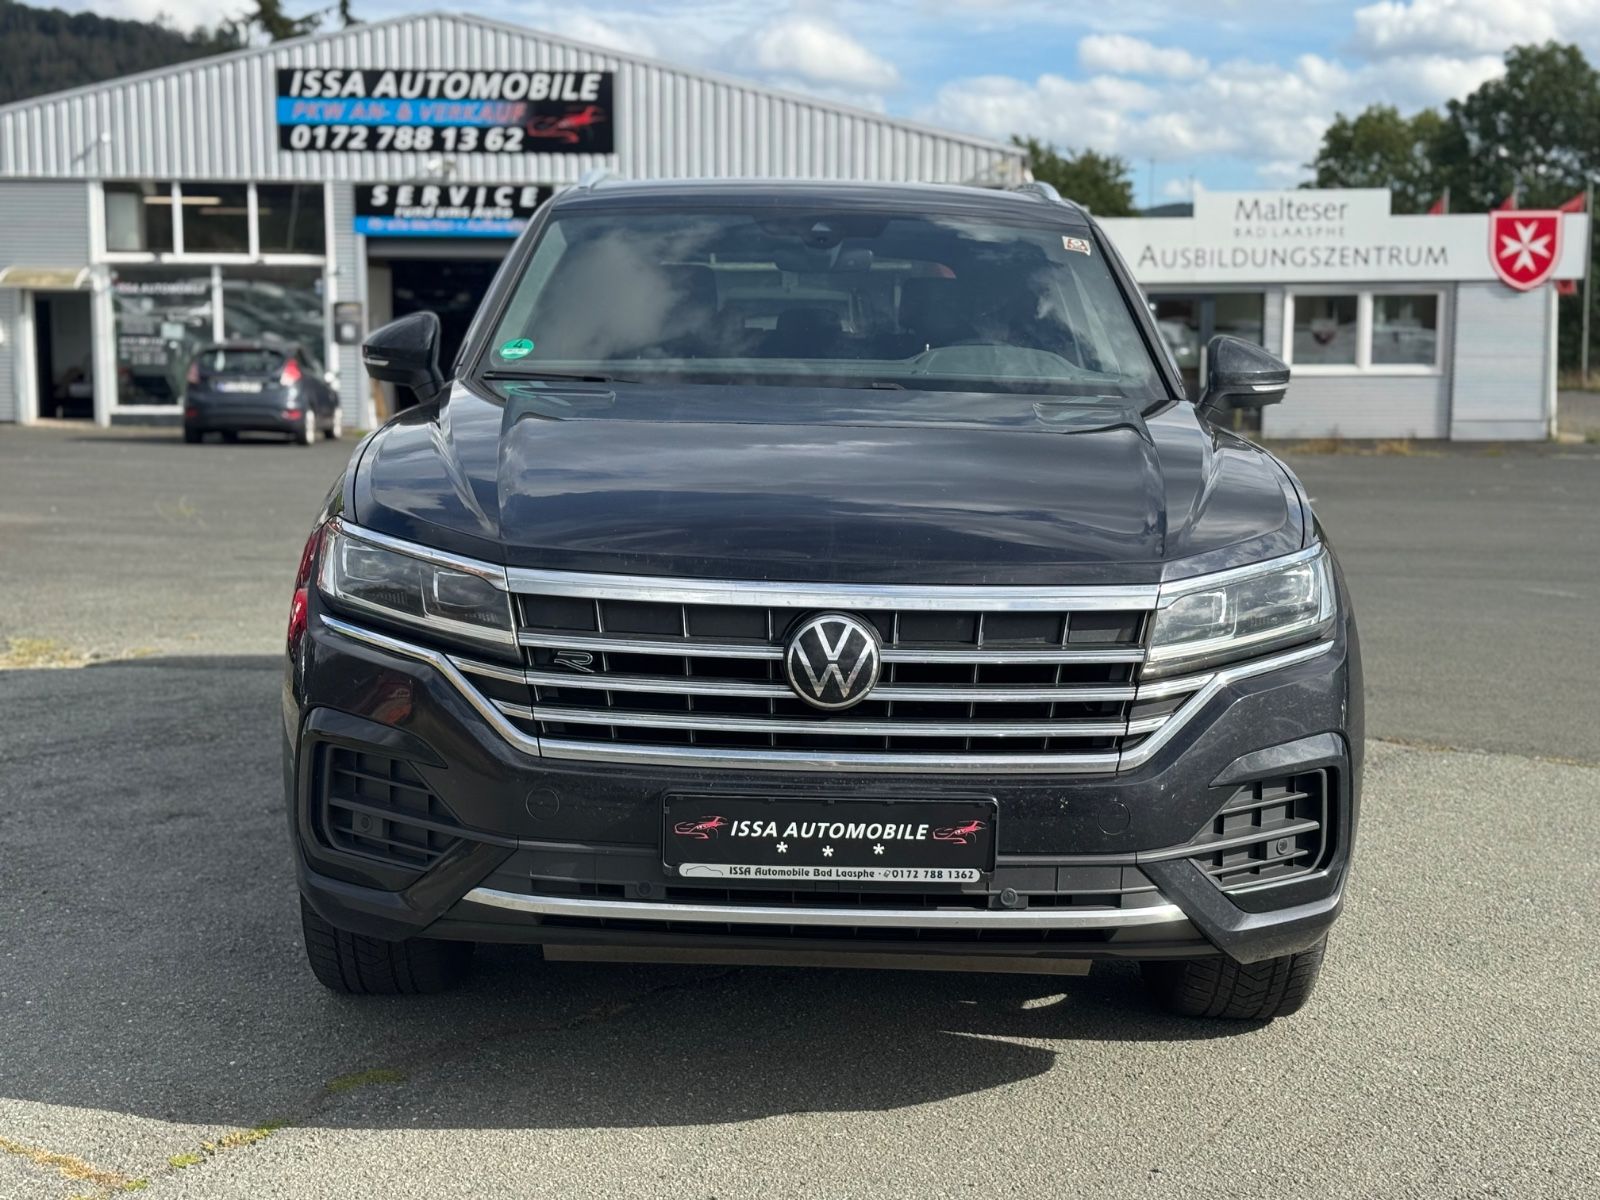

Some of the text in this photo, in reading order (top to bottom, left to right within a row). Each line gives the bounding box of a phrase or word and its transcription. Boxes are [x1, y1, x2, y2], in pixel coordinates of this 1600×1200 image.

[289, 70, 602, 100] ISSA AUTOMOBILE
[419, 102, 527, 125] VERKAUF
[290, 124, 525, 151] 0172 788 13 62
[371, 185, 539, 207] SERVICE
[1234, 199, 1348, 221] Malteser
[1234, 226, 1345, 238] BAD LAASPHE
[1138, 246, 1448, 268] AUSBILDUNGSZENTRUM
[730, 820, 929, 840] ISSA AUTOMOBILE
[729, 866, 974, 879] ISSA Automobile Bad Laasphe 0172 788 1362
